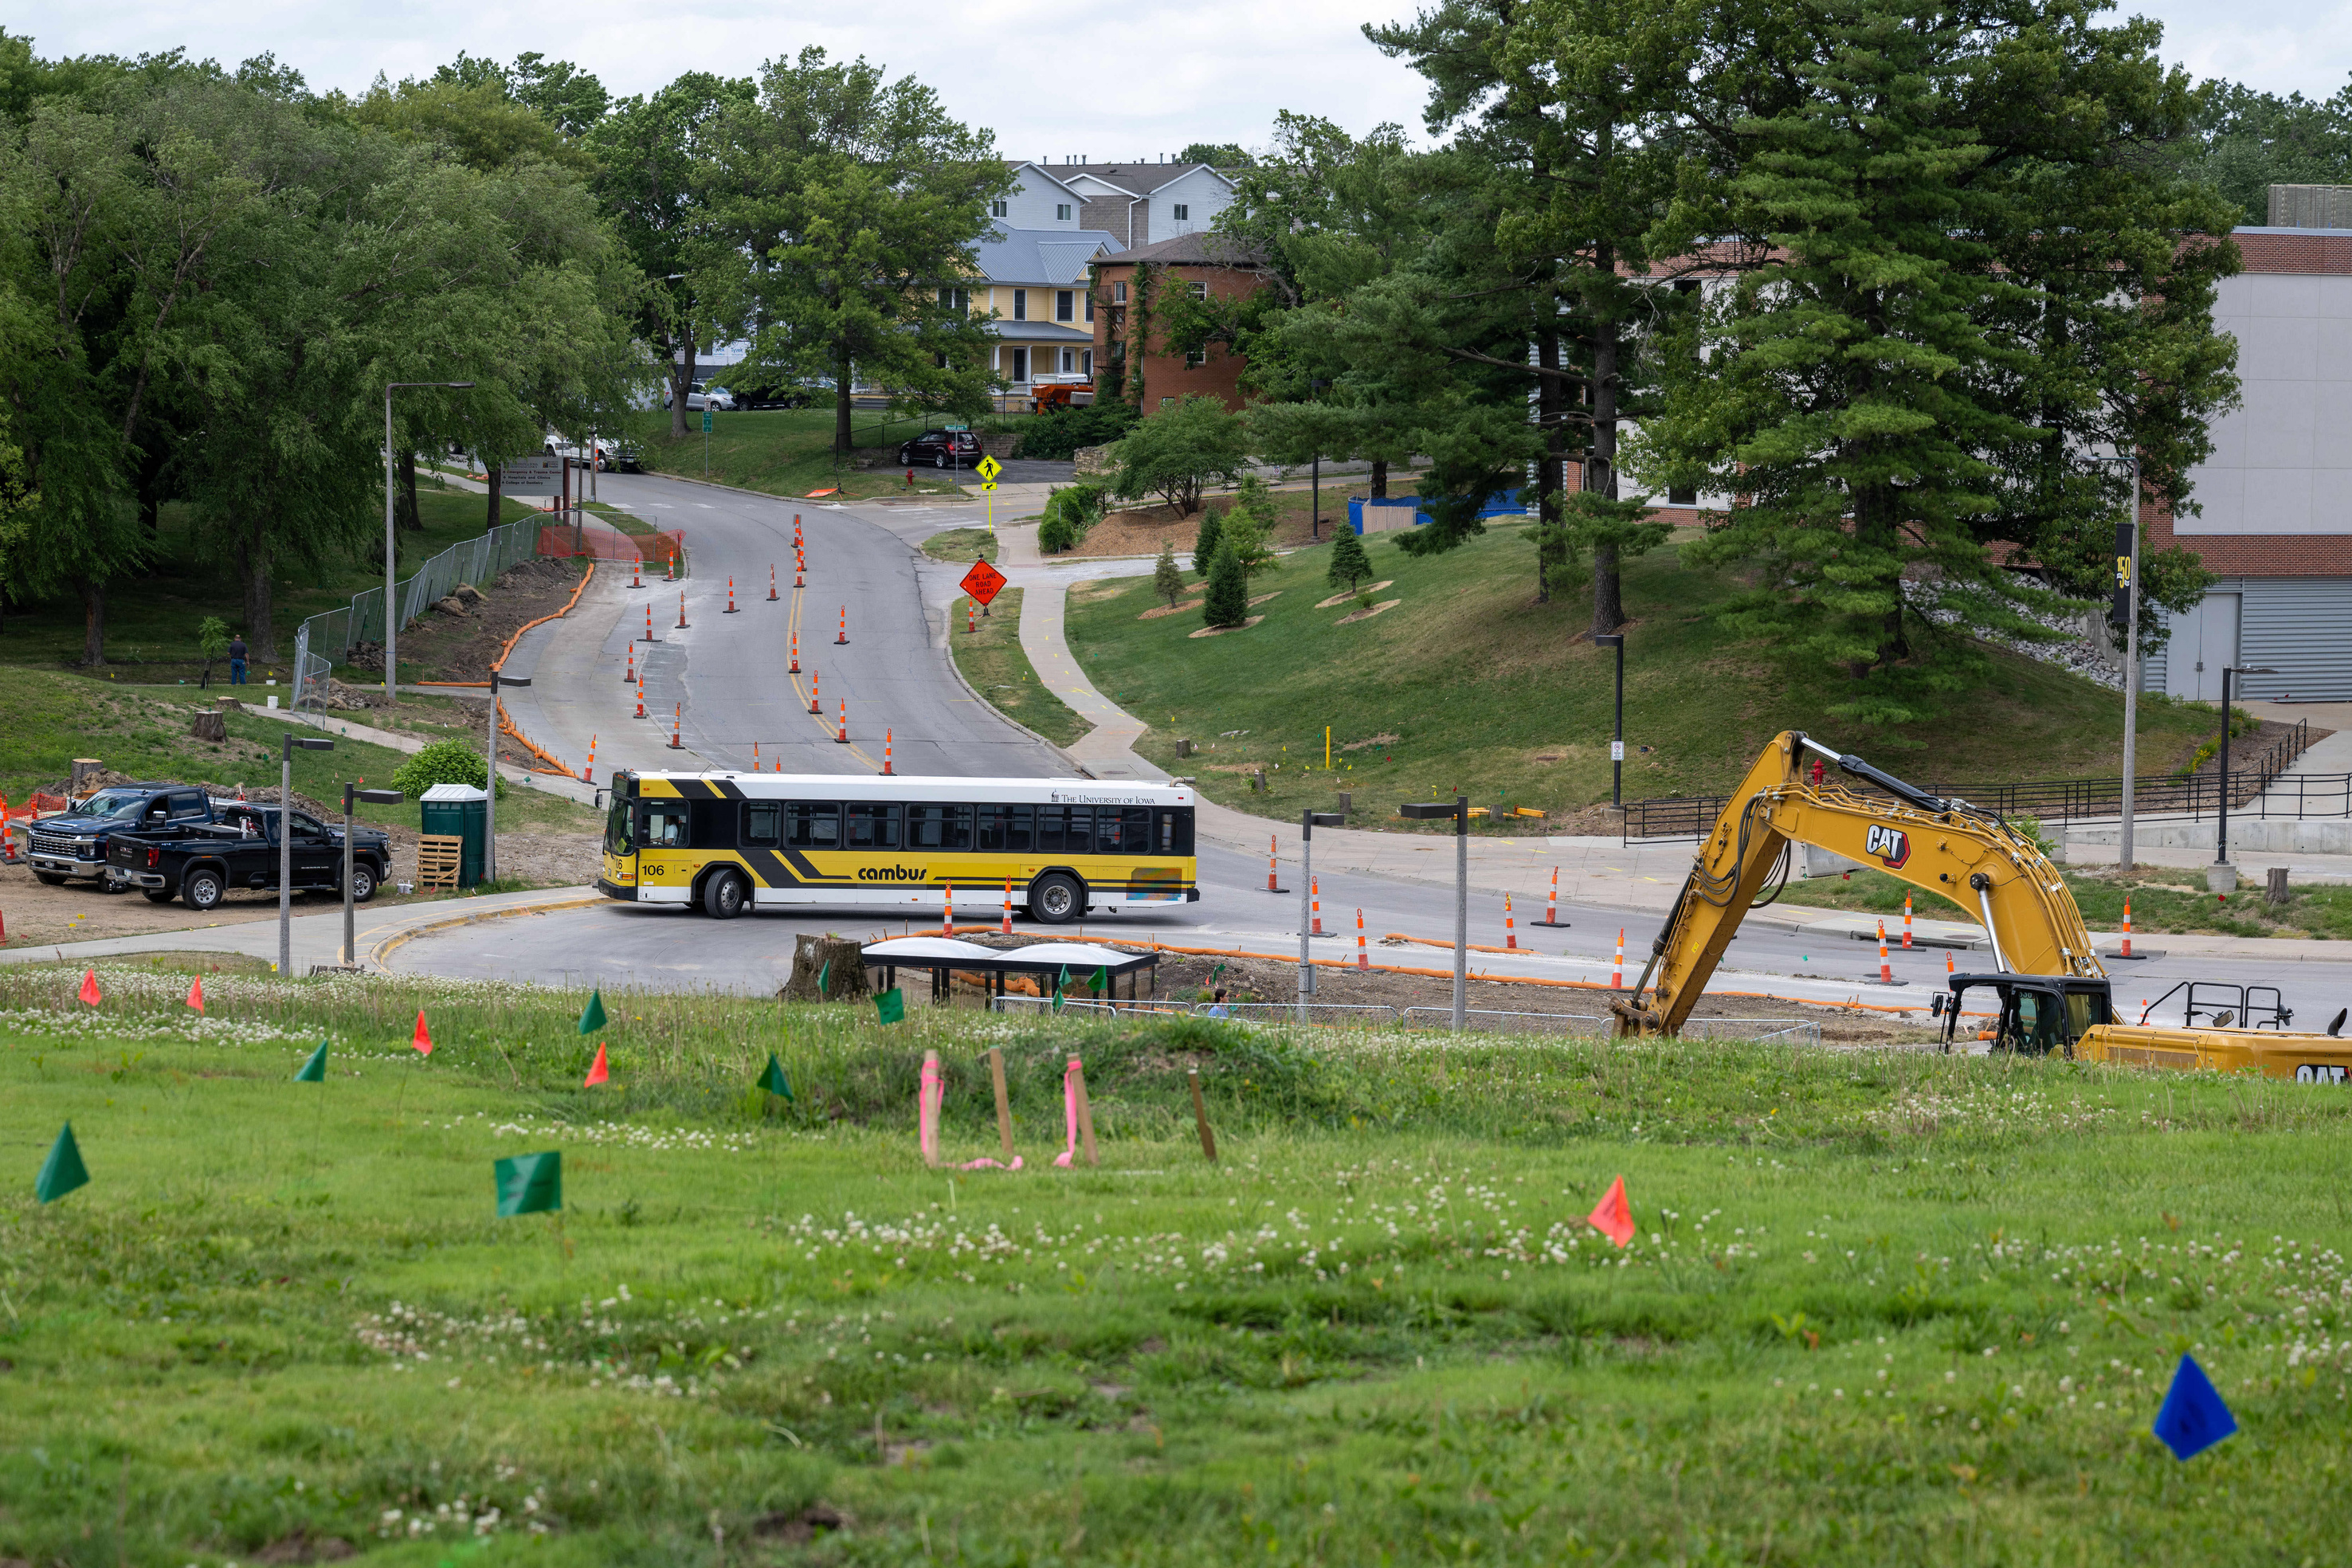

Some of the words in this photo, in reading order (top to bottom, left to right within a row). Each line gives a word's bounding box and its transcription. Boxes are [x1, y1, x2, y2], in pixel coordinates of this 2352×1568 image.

[2117, 556, 2131, 589] 150
[1866, 824, 1903, 860] CAT
[641, 864, 664, 876] 106
[858, 864, 927, 880] cambus
[2297, 1065, 2345, 1086] CAT
